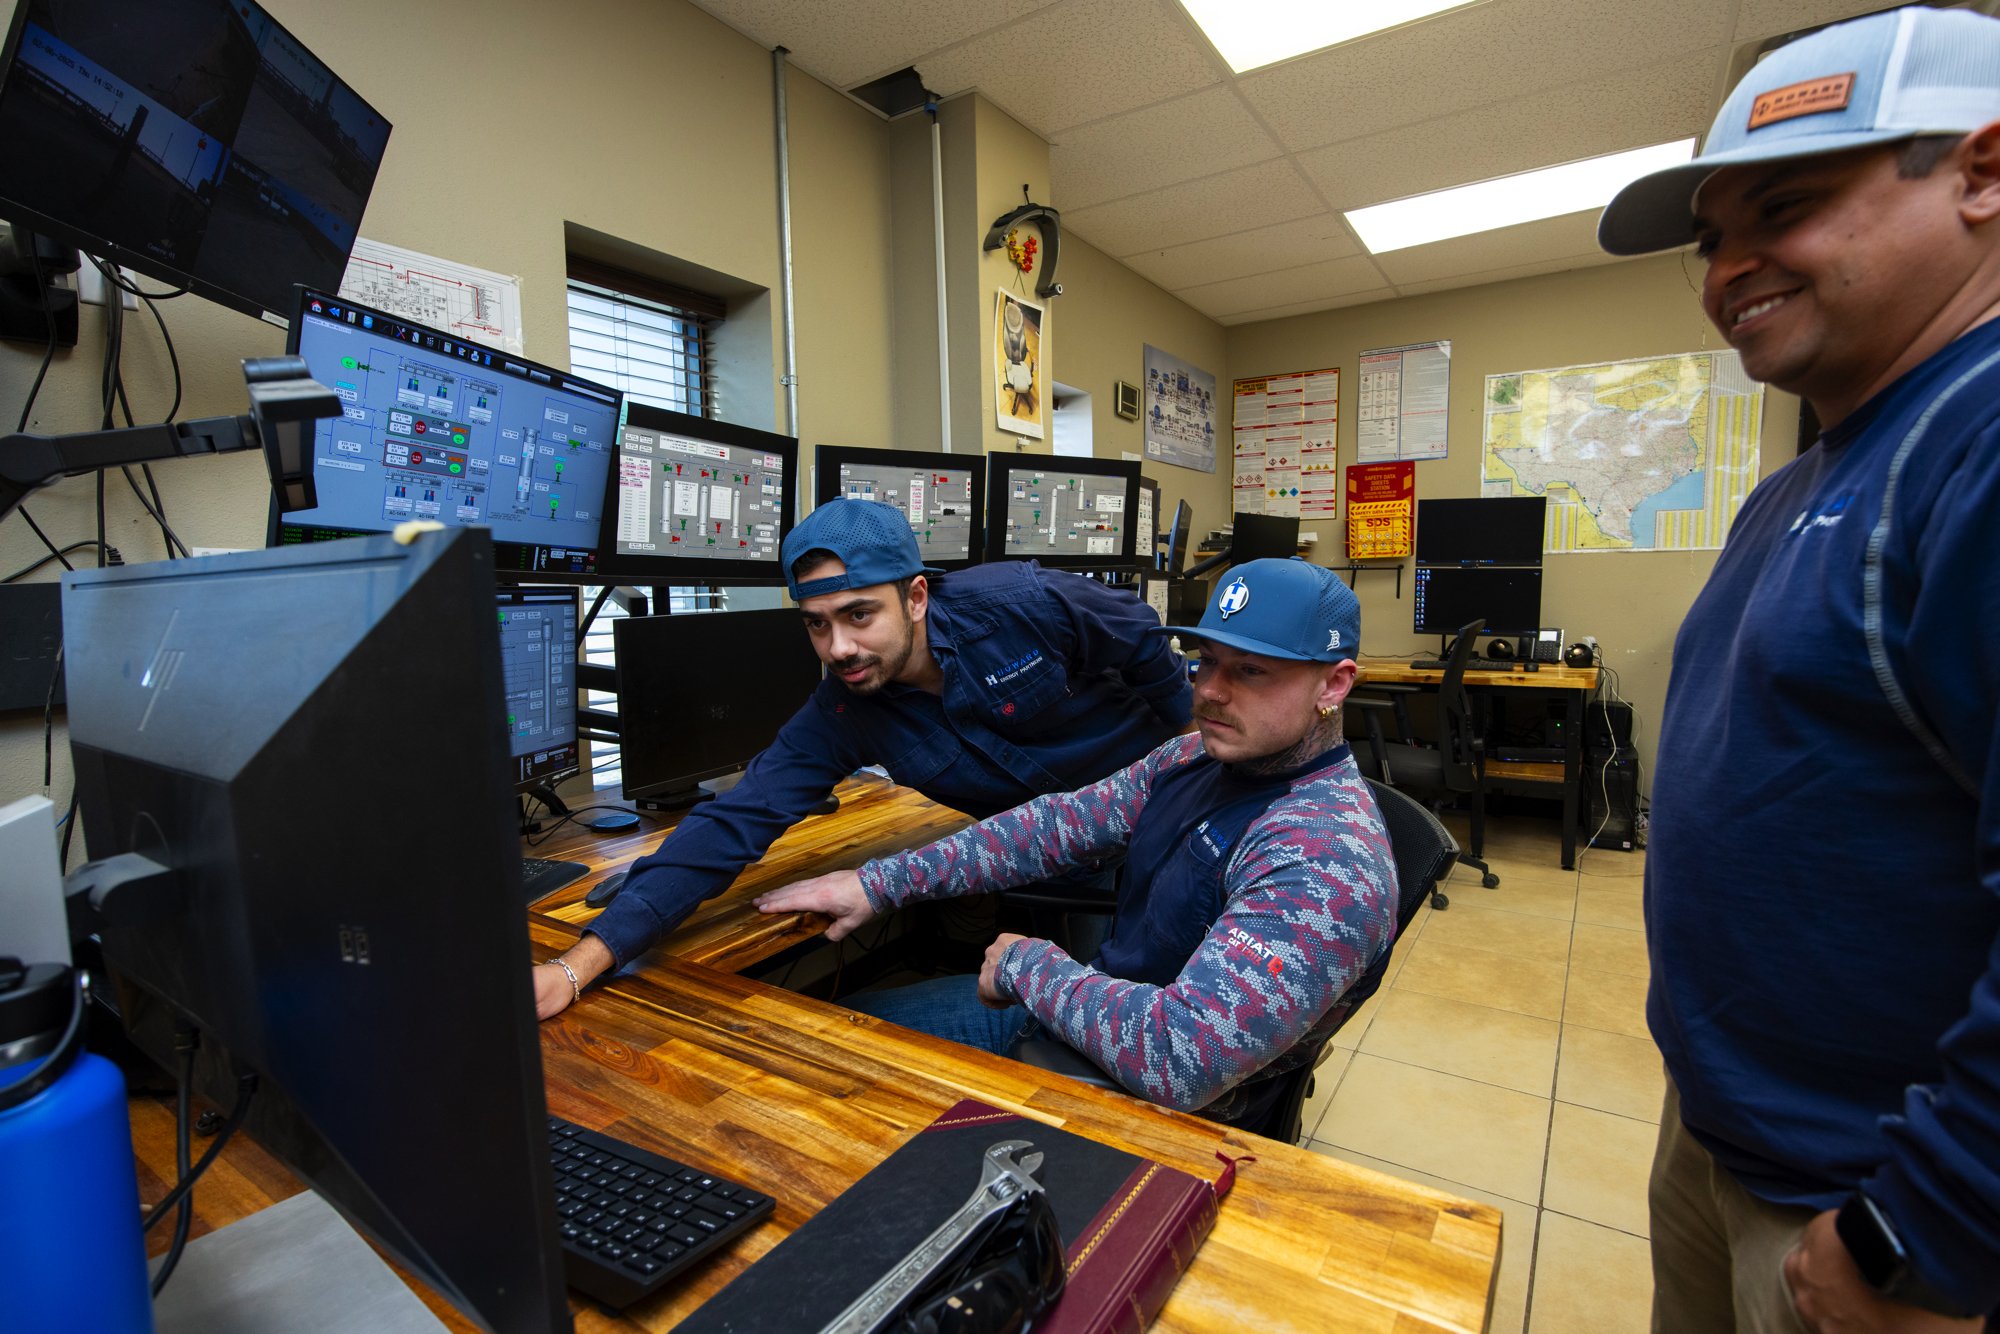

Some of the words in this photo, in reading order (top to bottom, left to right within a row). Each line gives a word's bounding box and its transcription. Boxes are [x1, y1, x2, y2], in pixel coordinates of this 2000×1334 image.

[1366, 517, 1391, 527] SDS
[996, 649, 1039, 676] HOWARD
[1228, 927, 1275, 959] ARIAT
